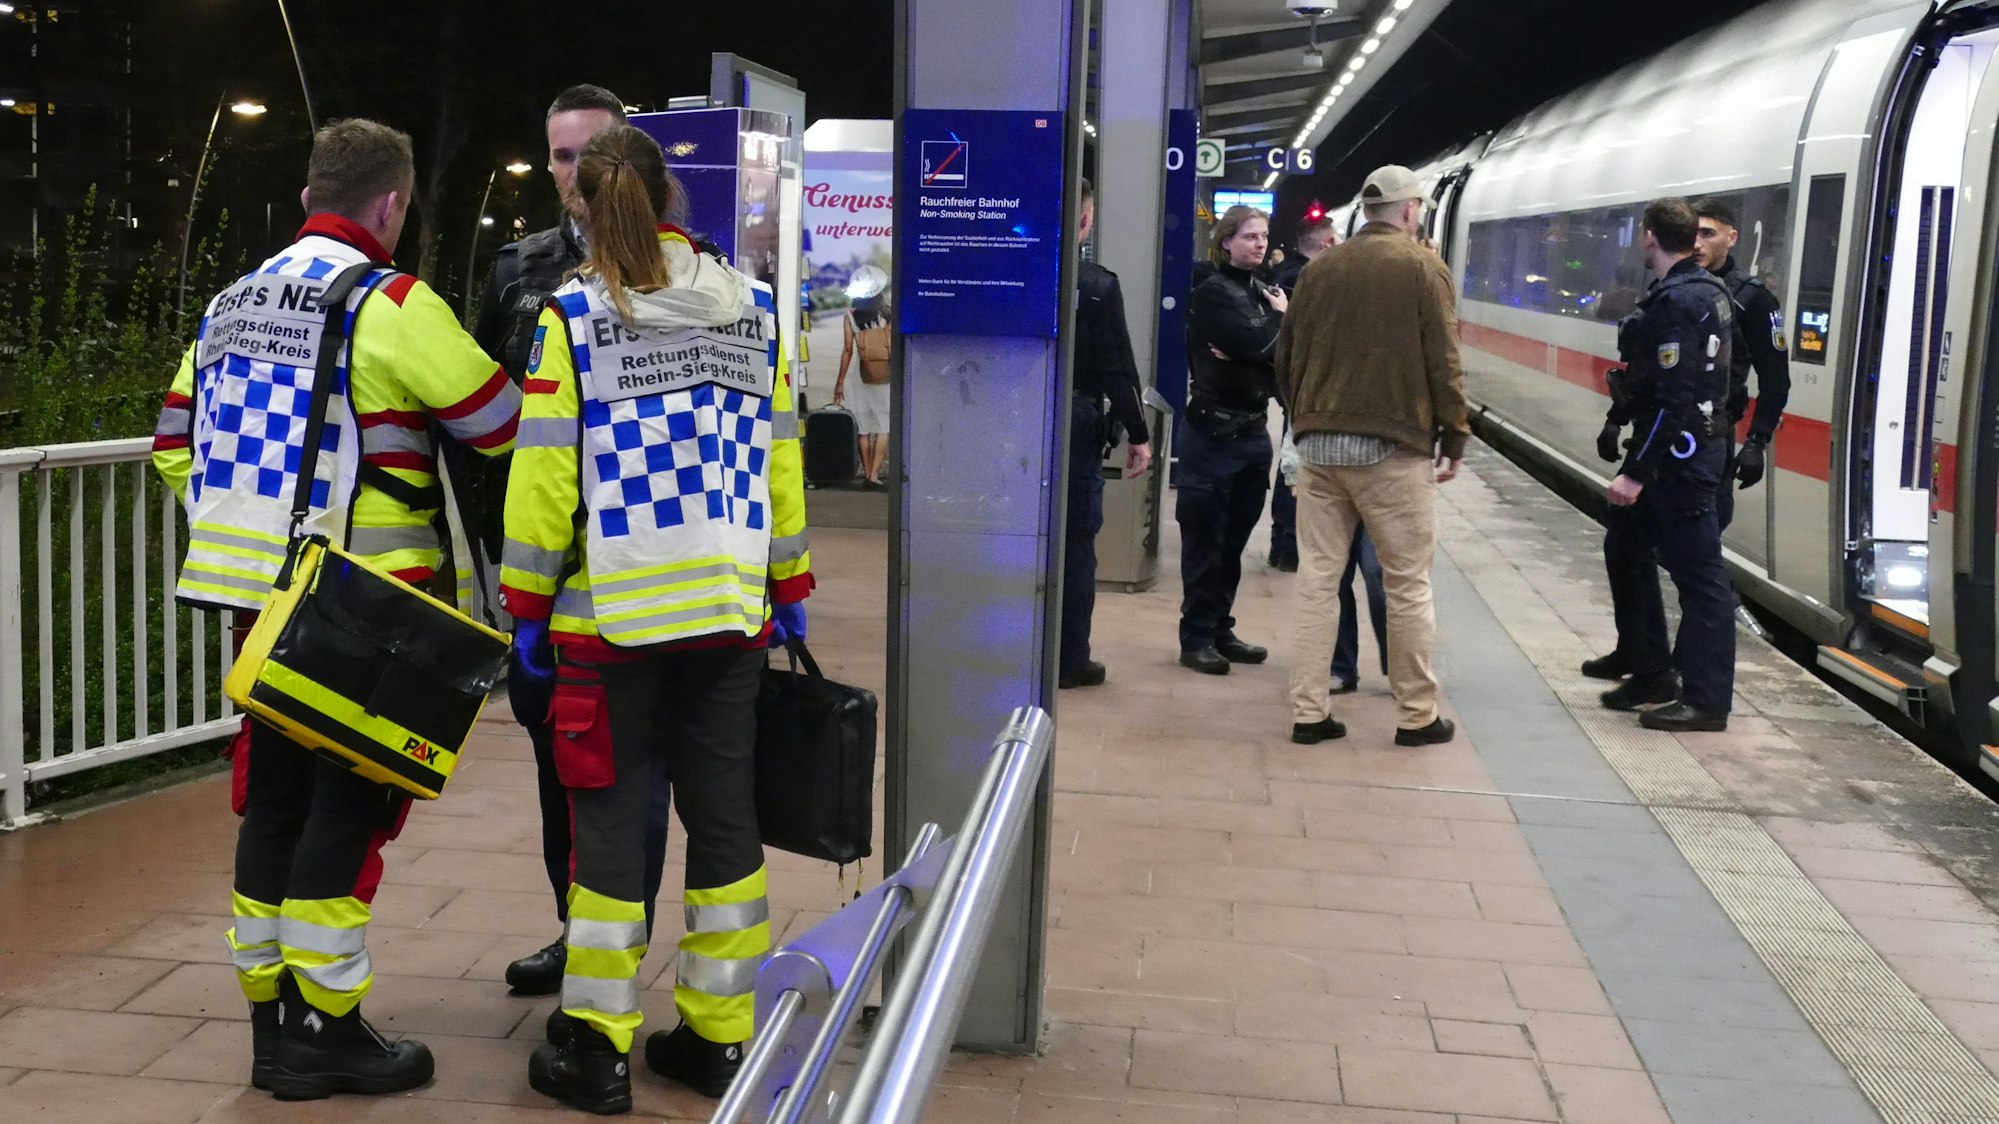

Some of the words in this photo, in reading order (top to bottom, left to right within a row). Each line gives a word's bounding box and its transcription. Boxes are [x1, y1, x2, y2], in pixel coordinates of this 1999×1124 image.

[1267, 148, 1284, 169] C
[1296, 148, 1313, 170] 6
[920, 196, 976, 207] Rauchfreier
[978, 197, 1020, 208] Bahnhof
[920, 209, 975, 221] Non-Smoking
[977, 210, 1006, 220] Station
[1750, 220, 1763, 277] 2
[277, 283, 328, 314] NE
[621, 343, 751, 371] Rettungsdienst
[402, 736, 441, 766] PAX
